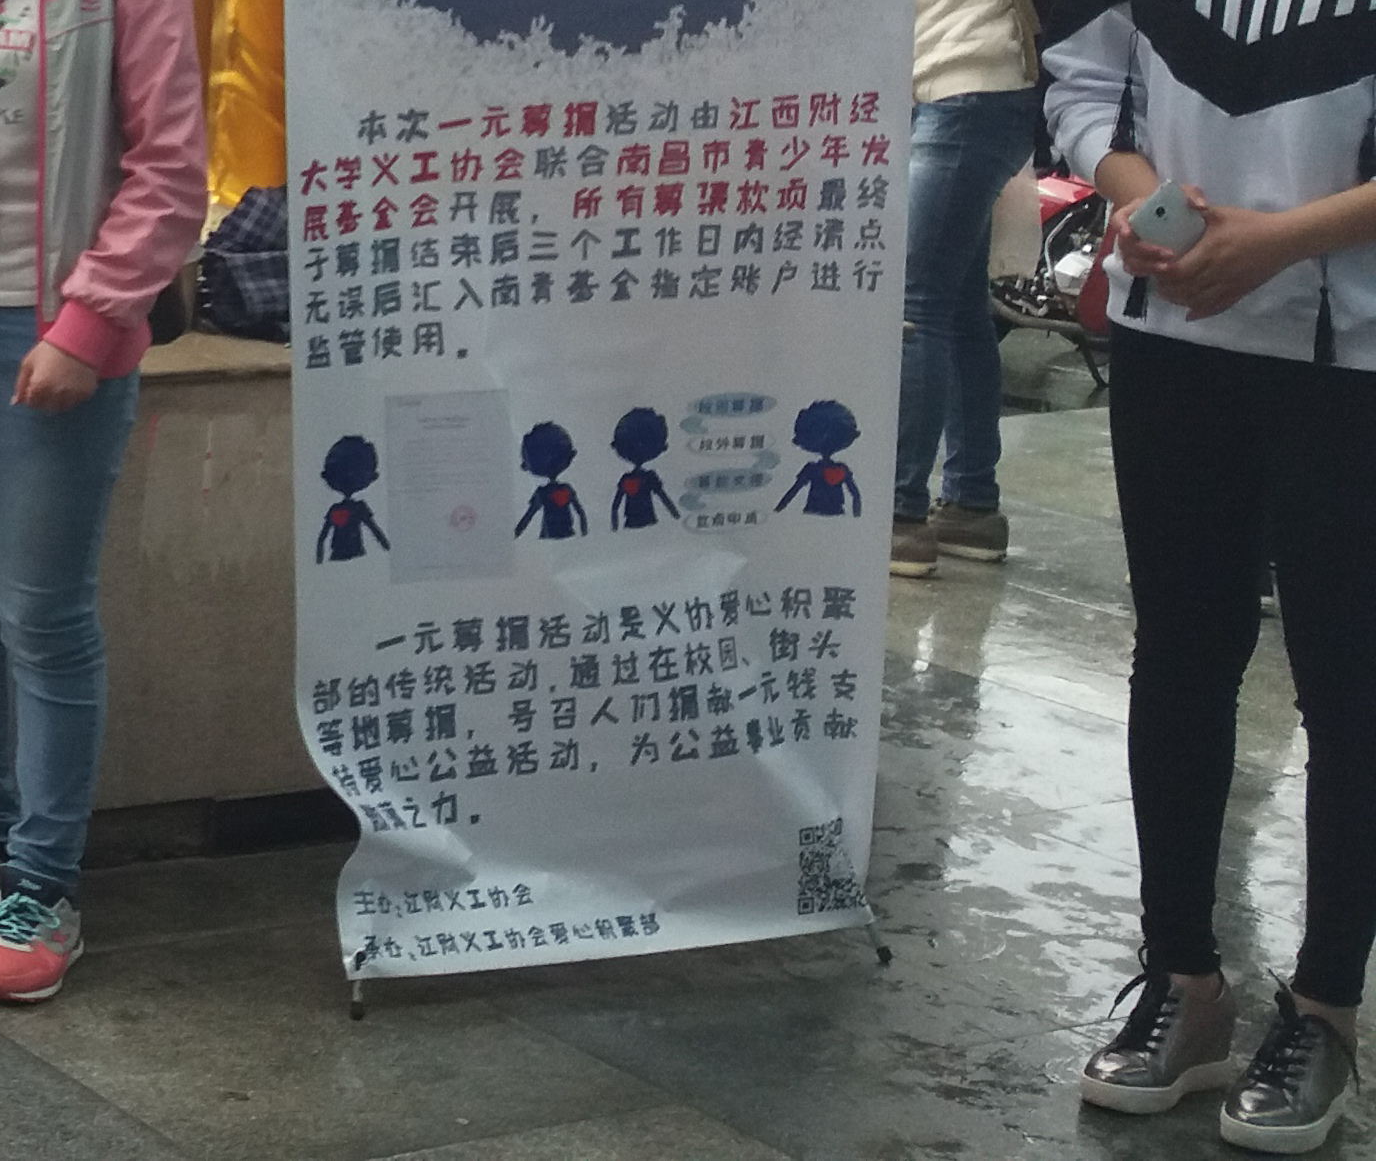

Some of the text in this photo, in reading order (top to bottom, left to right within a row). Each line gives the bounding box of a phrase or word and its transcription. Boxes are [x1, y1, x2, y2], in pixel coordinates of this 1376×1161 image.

[358, 92, 881, 145] 本次一元募捐活动由江西财经
[300, 135, 891, 196] 大学义工协会联合南昌市青少年发
[304, 219, 887, 281] 于募捐结束后三个工作日内经清点
[305, 260, 885, 326] 无误后汇入南青基金指定账户进行
[375, 586, 858, 651] 一元募捐活动是义协爱心积聚
